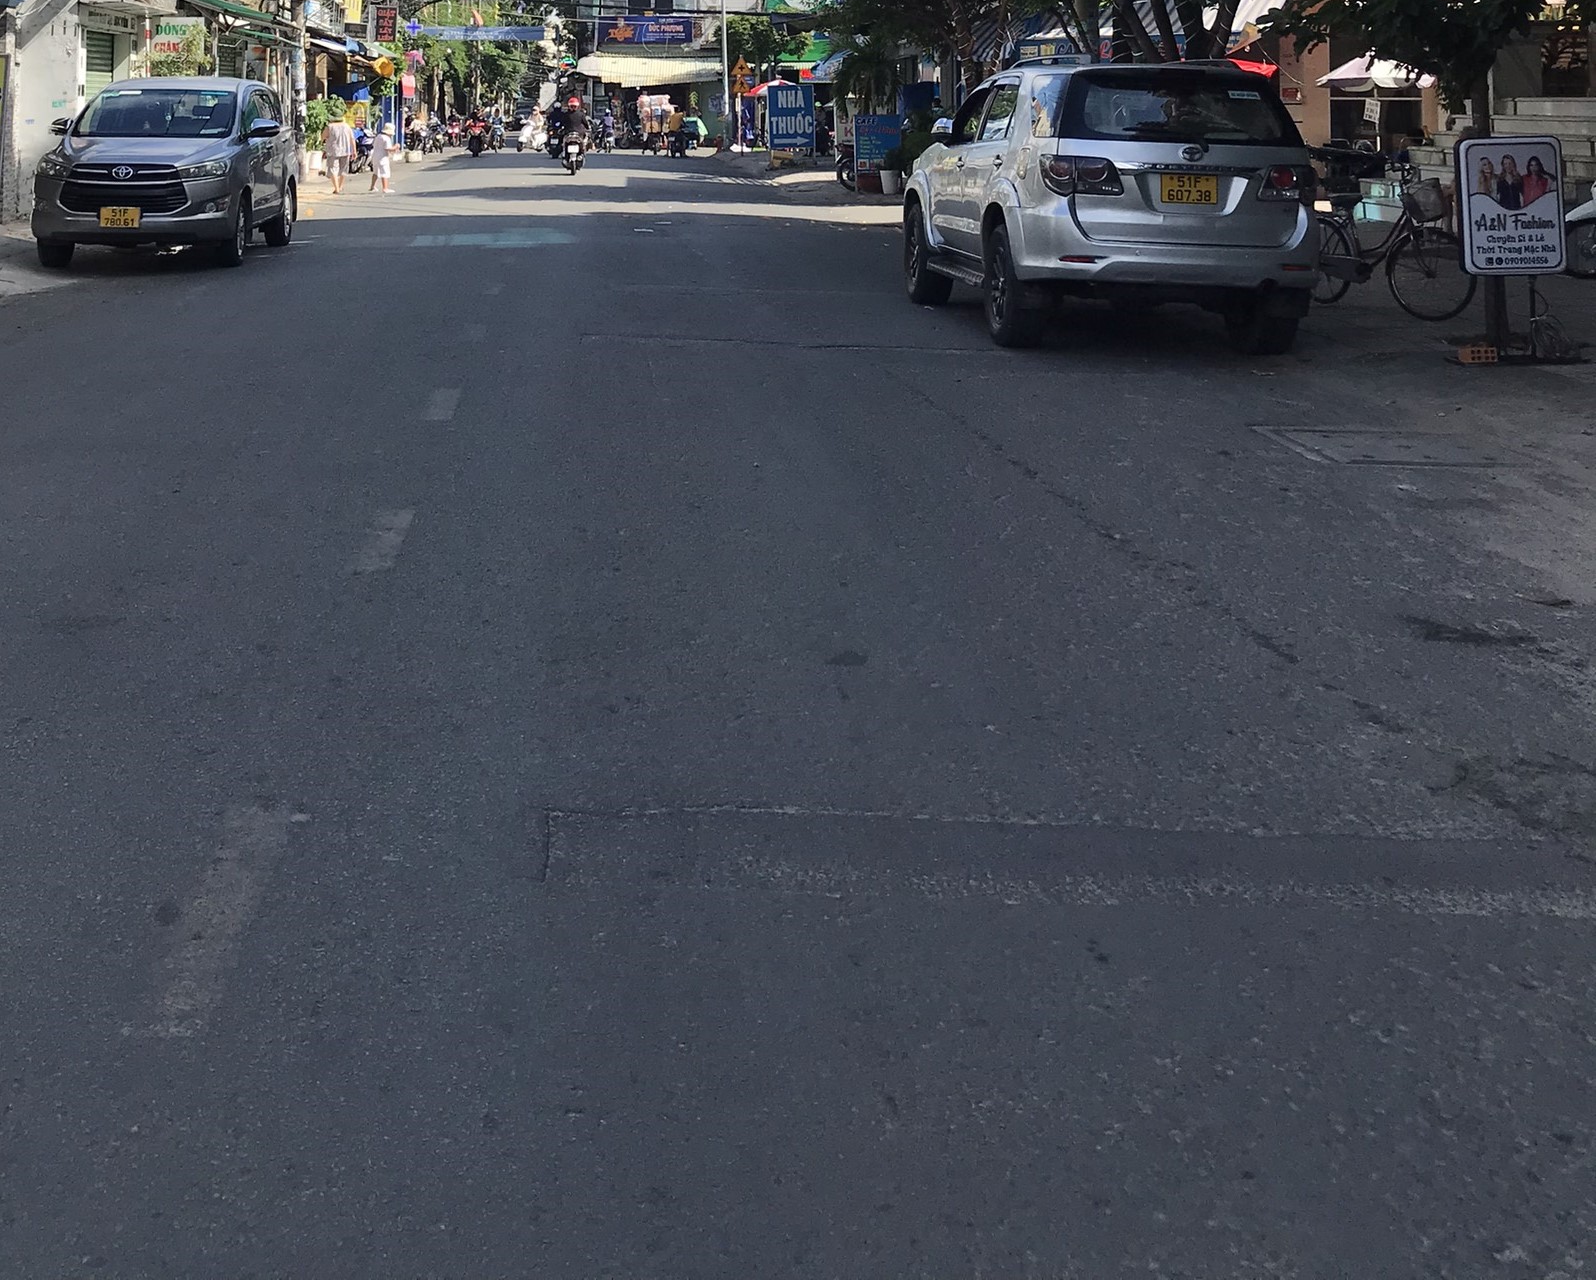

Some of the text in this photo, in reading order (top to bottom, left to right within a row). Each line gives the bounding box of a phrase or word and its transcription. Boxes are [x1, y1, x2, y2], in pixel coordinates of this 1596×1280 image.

[777, 87, 805, 108] NHÀ
[771, 111, 813, 135] THUỐC
[1177, 176, 1201, 188] 51F
[1167, 189, 1211, 202] 607.38
[111, 208, 129, 217] 51F
[104, 217, 135, 226] 780.61
[1474, 213, 1556, 231] A&N Fashion
[1486, 234, 1516, 244] Chuyên
[1528, 234, 1534, 242] &
[1476, 246, 1495, 254] Thời
[1497, 245, 1522, 255] Trang
[1541, 244, 1557, 253] Nhà
